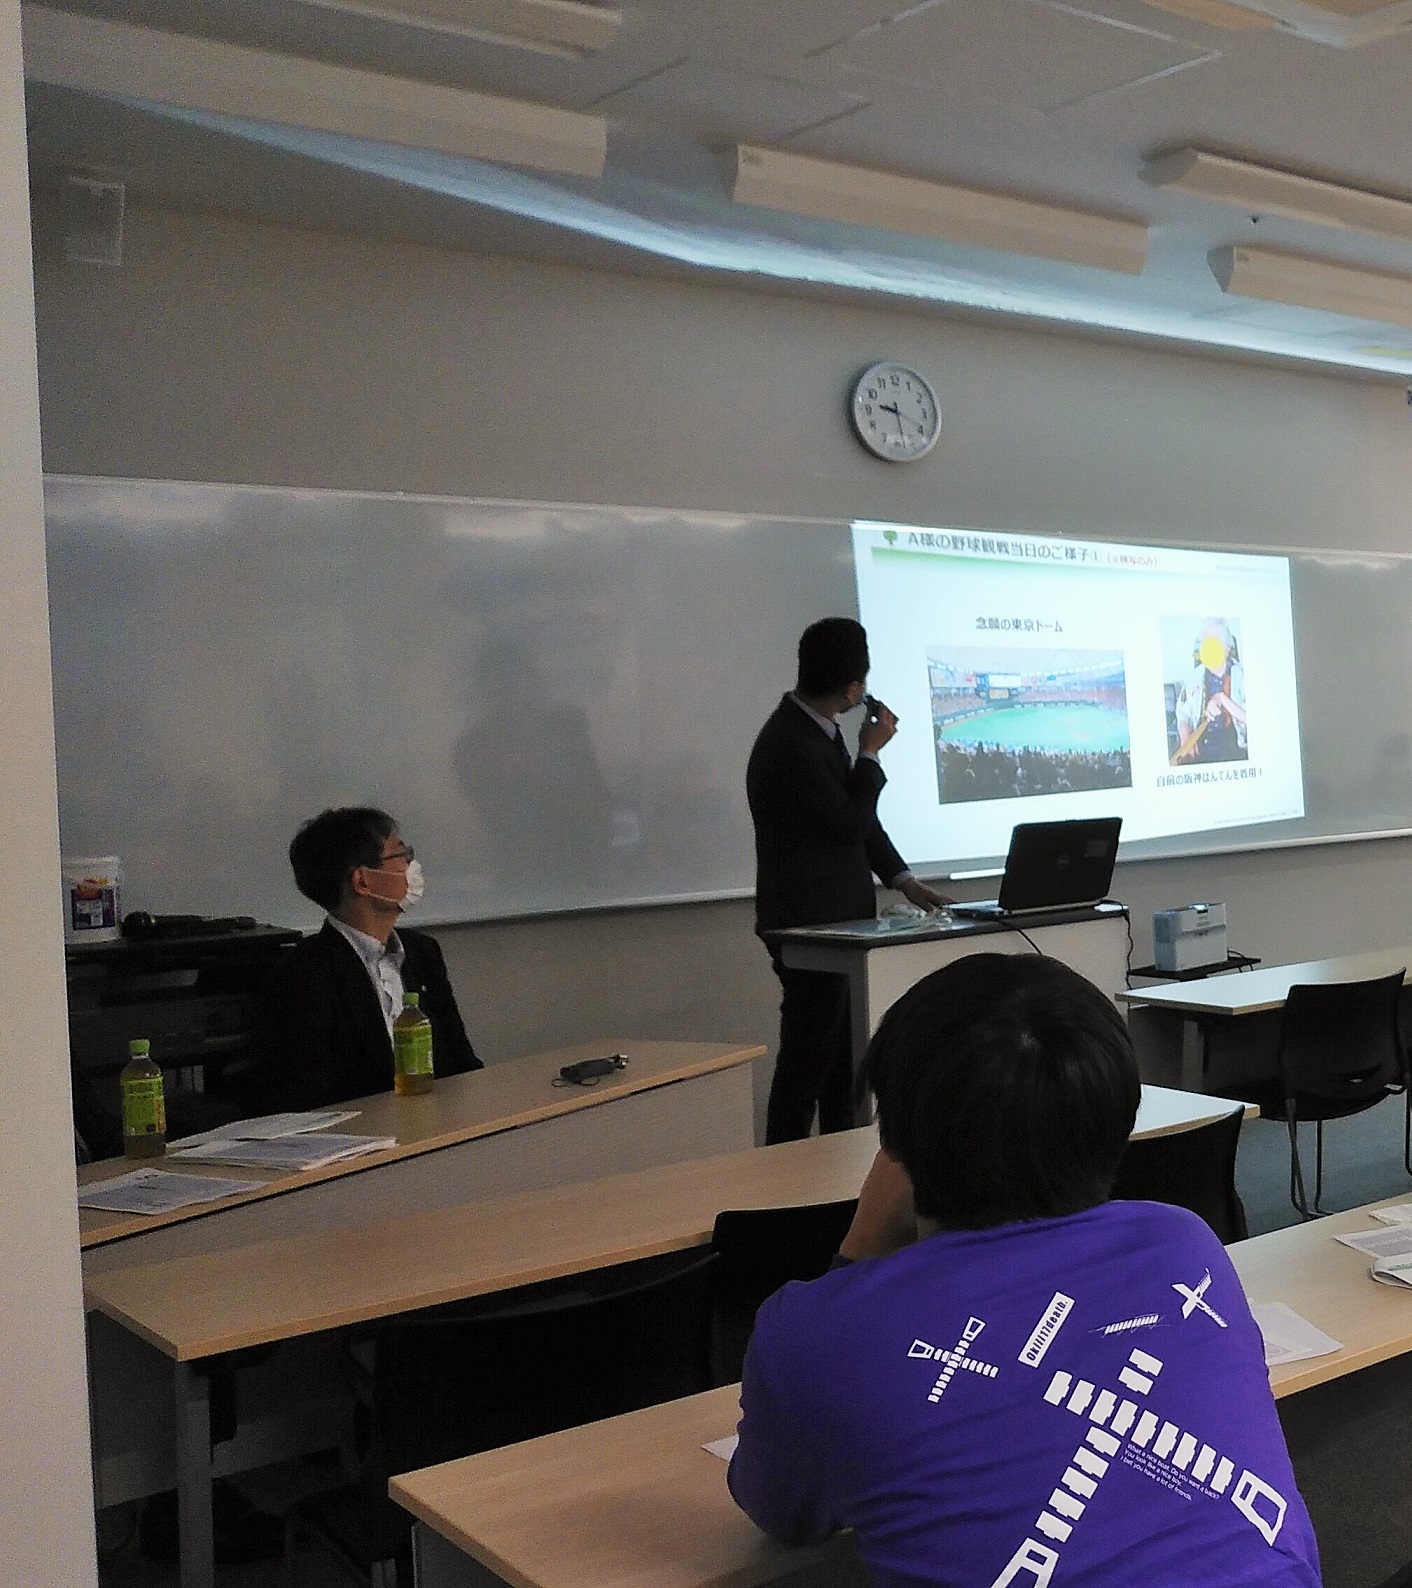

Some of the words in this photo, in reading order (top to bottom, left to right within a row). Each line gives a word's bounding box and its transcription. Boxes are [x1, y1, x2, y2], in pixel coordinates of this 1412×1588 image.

[975, 616, 1063, 632] 念願の東京ドーム
